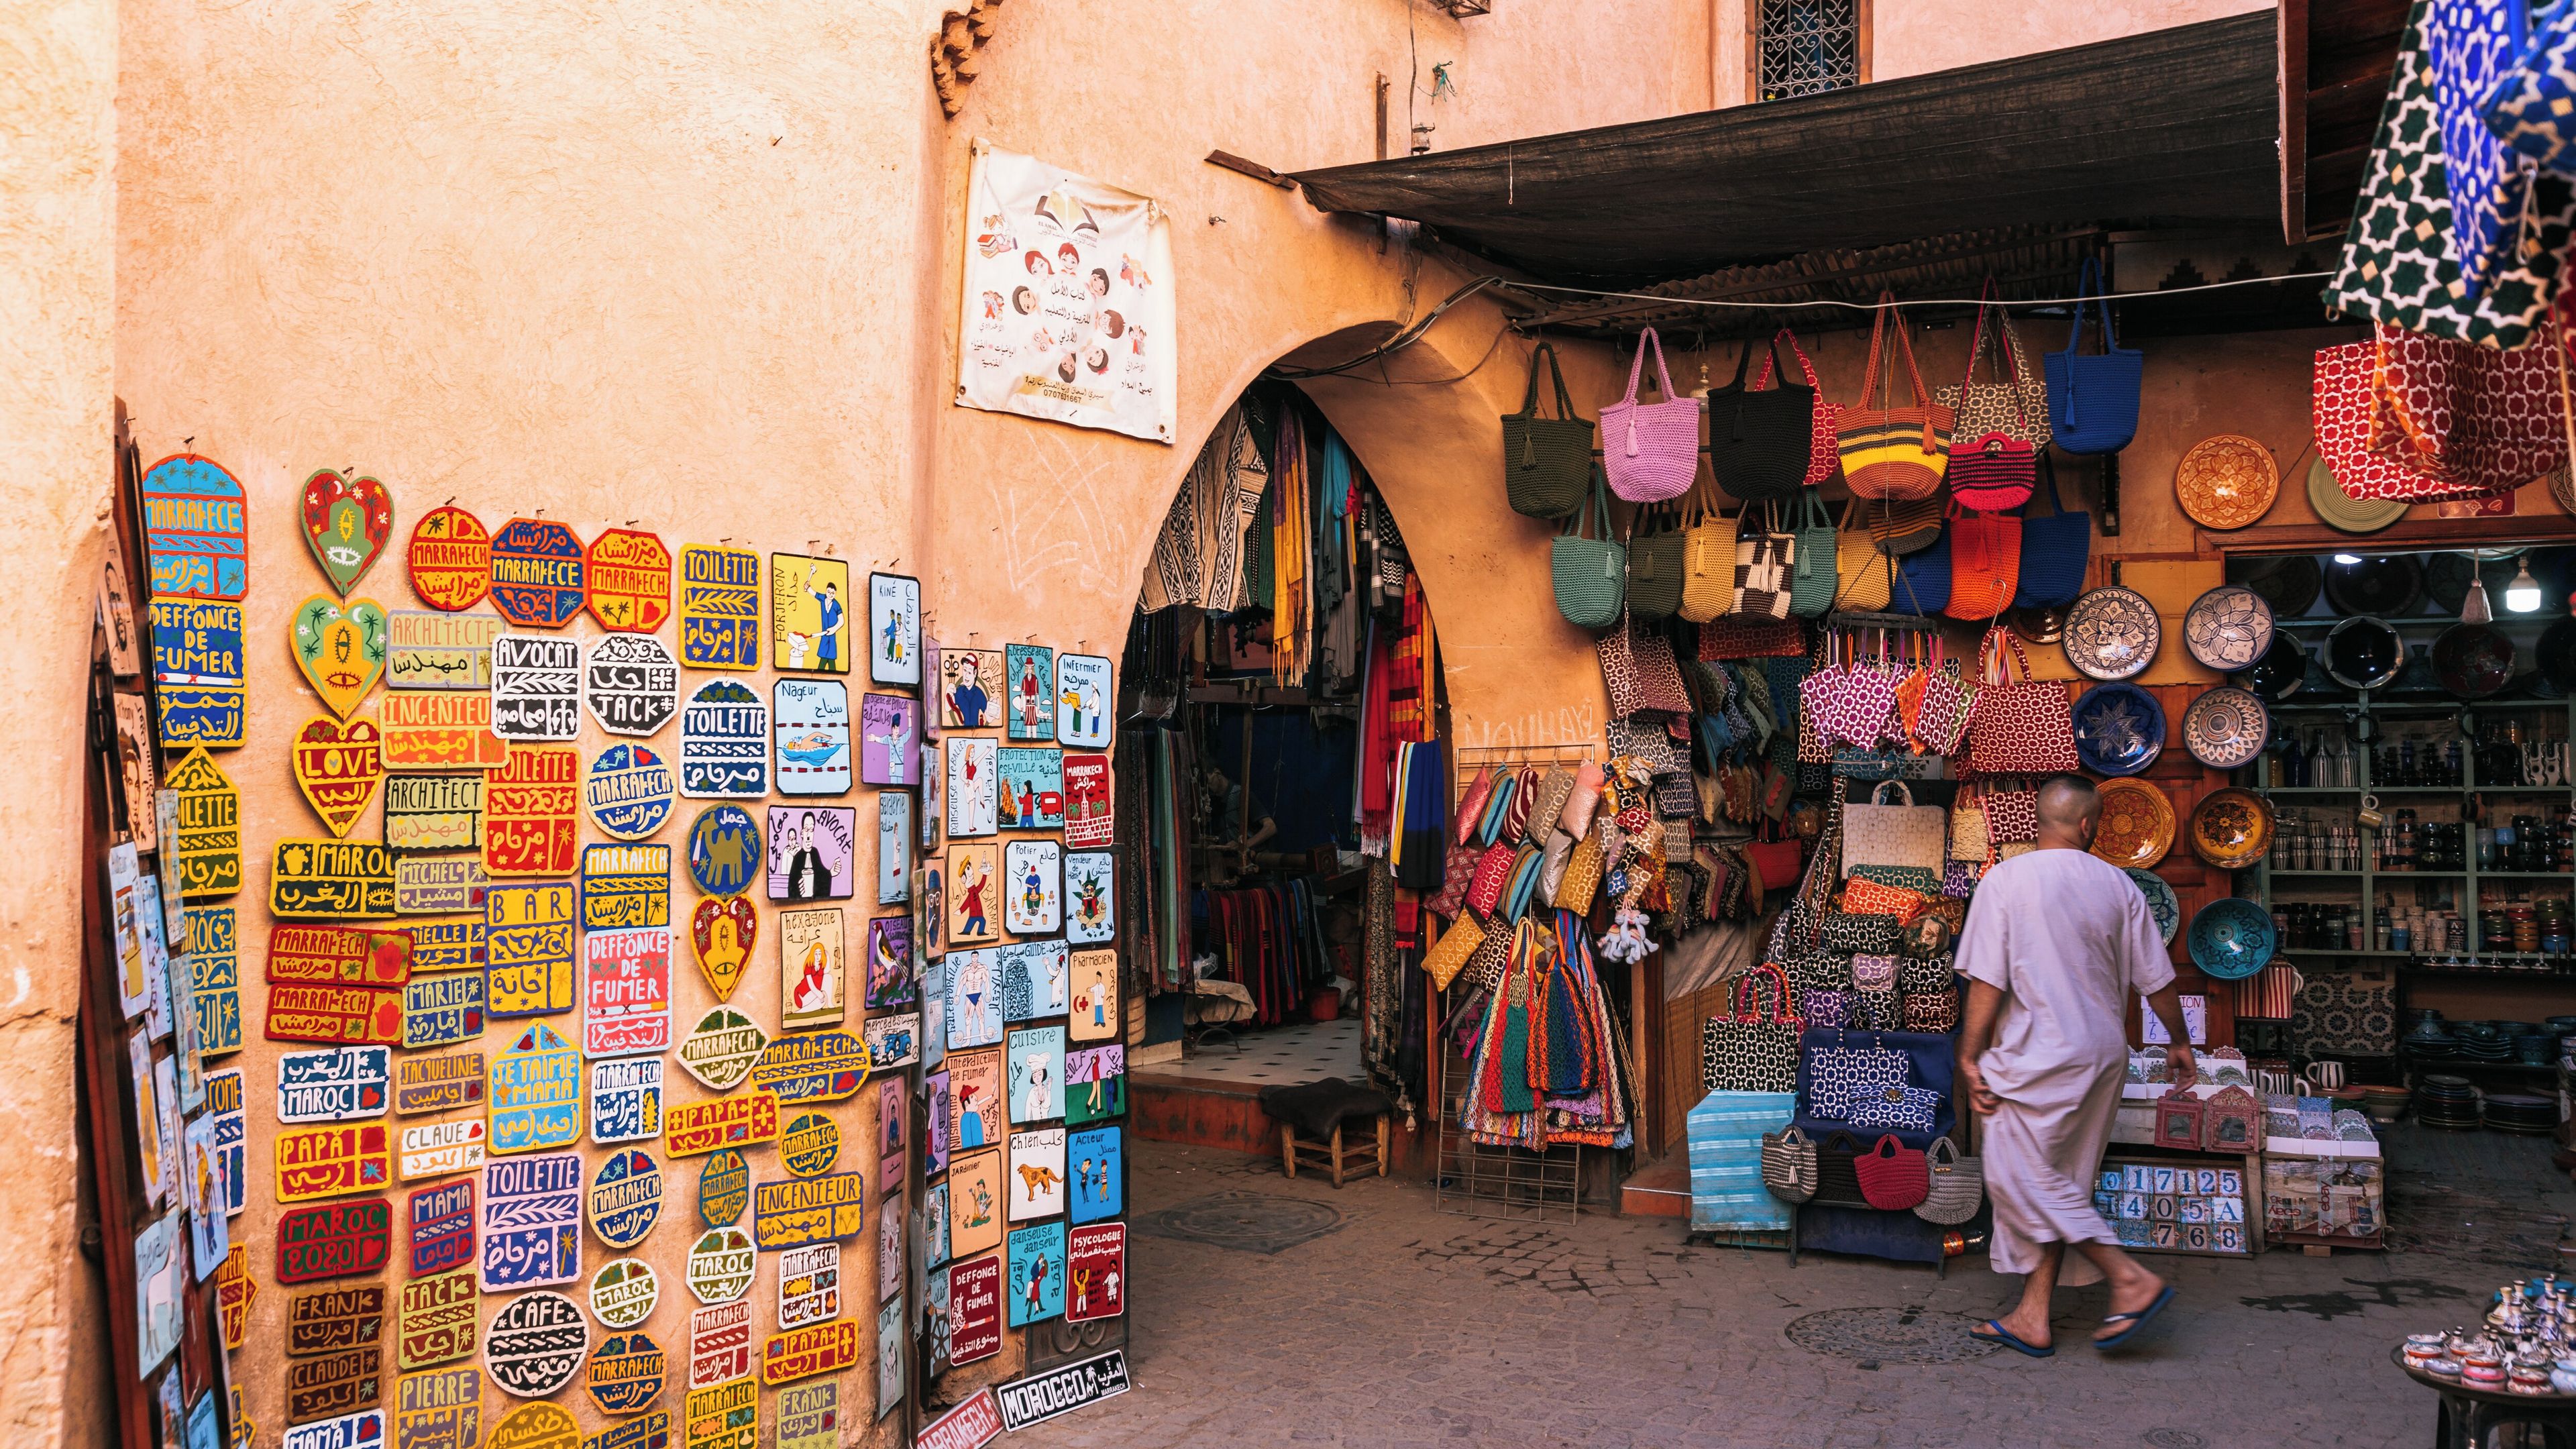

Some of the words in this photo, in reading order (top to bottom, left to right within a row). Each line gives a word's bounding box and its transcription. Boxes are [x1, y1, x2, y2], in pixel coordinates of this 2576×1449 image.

[1043, 389, 1082, 403] 0707631667
[150, 605, 239, 632] DEFFONCE
[393, 616, 496, 646] ARCHITECTE
[184, 630, 208, 650] DE
[498, 637, 575, 668] AVOCAT
[155, 646, 237, 676] FUMER
[385, 697, 490, 725] INGENIEU
[596, 696, 658, 722] JACK
[305, 748, 377, 777] LOVE
[999, 749, 1047, 761] PROTECTION
[1066, 763, 1104, 777] MARRAKECH
[390, 781, 482, 809] ARCHITECT
[400, 863, 460, 883] MICHEL
[493, 890, 566, 924] BAR
[981, 883, 998, 936] BARMEN
[592, 932, 667, 961] DEFFONCE
[1024, 942, 1046, 957] GUIDE
[621, 958, 641, 977] DE
[592, 978, 661, 1004] FUMER
[494, 1061, 515, 1085] JE
[286, 1084, 350, 1114] MAROC
[513, 1079, 573, 1103] MAMA
[689, 1103, 738, 1128] PAPA
[282, 1130, 343, 1163] PAPA
[2156, 1169, 2171, 1191] 7
[2200, 1171, 2214, 1192] 2
[2222, 1171, 2237, 1193] 5
[415, 1185, 470, 1222] MAMA
[759, 1180, 858, 1213] INGENIEUR
[2126, 1196, 2141, 1216] 4
[2189, 1199, 2204, 1220] 5
[2217, 1199, 2239, 1222] A
[2320, 1180, 2332, 1212] ebay
[287, 1205, 382, 1241] MAROC
[1010, 1225, 1053, 1246] danseuse
[2157, 1223, 2172, 1244] 7
[2190, 1227, 2205, 1247] 6
[2222, 1228, 2236, 1248] 8
[1024, 1234, 1059, 1254] danseur
[1073, 1229, 1122, 1248] PSYCOLOGUE
[691, 1253, 750, 1275] MAROC
[955, 1265, 998, 1287] DEFFONCE
[405, 1278, 469, 1311] JACK
[596, 1280, 651, 1308] MAROC
[971, 1281, 981, 1295] DE
[296, 1291, 374, 1319] FRANK
[509, 1299, 566, 1329] CAFE
[966, 1291, 994, 1313] FUMER
[790, 1330, 828, 1351] PAPA
[294, 1354, 358, 1385] CLAUDE
[402, 1372, 472, 1409] PIERRE
[782, 1387, 832, 1416] FRANK
[1003, 1368, 1088, 1427] MOROCCO
[1100, 1382, 1126, 1397] MARRAKECH
[290, 1426, 343, 1449] MAMA
